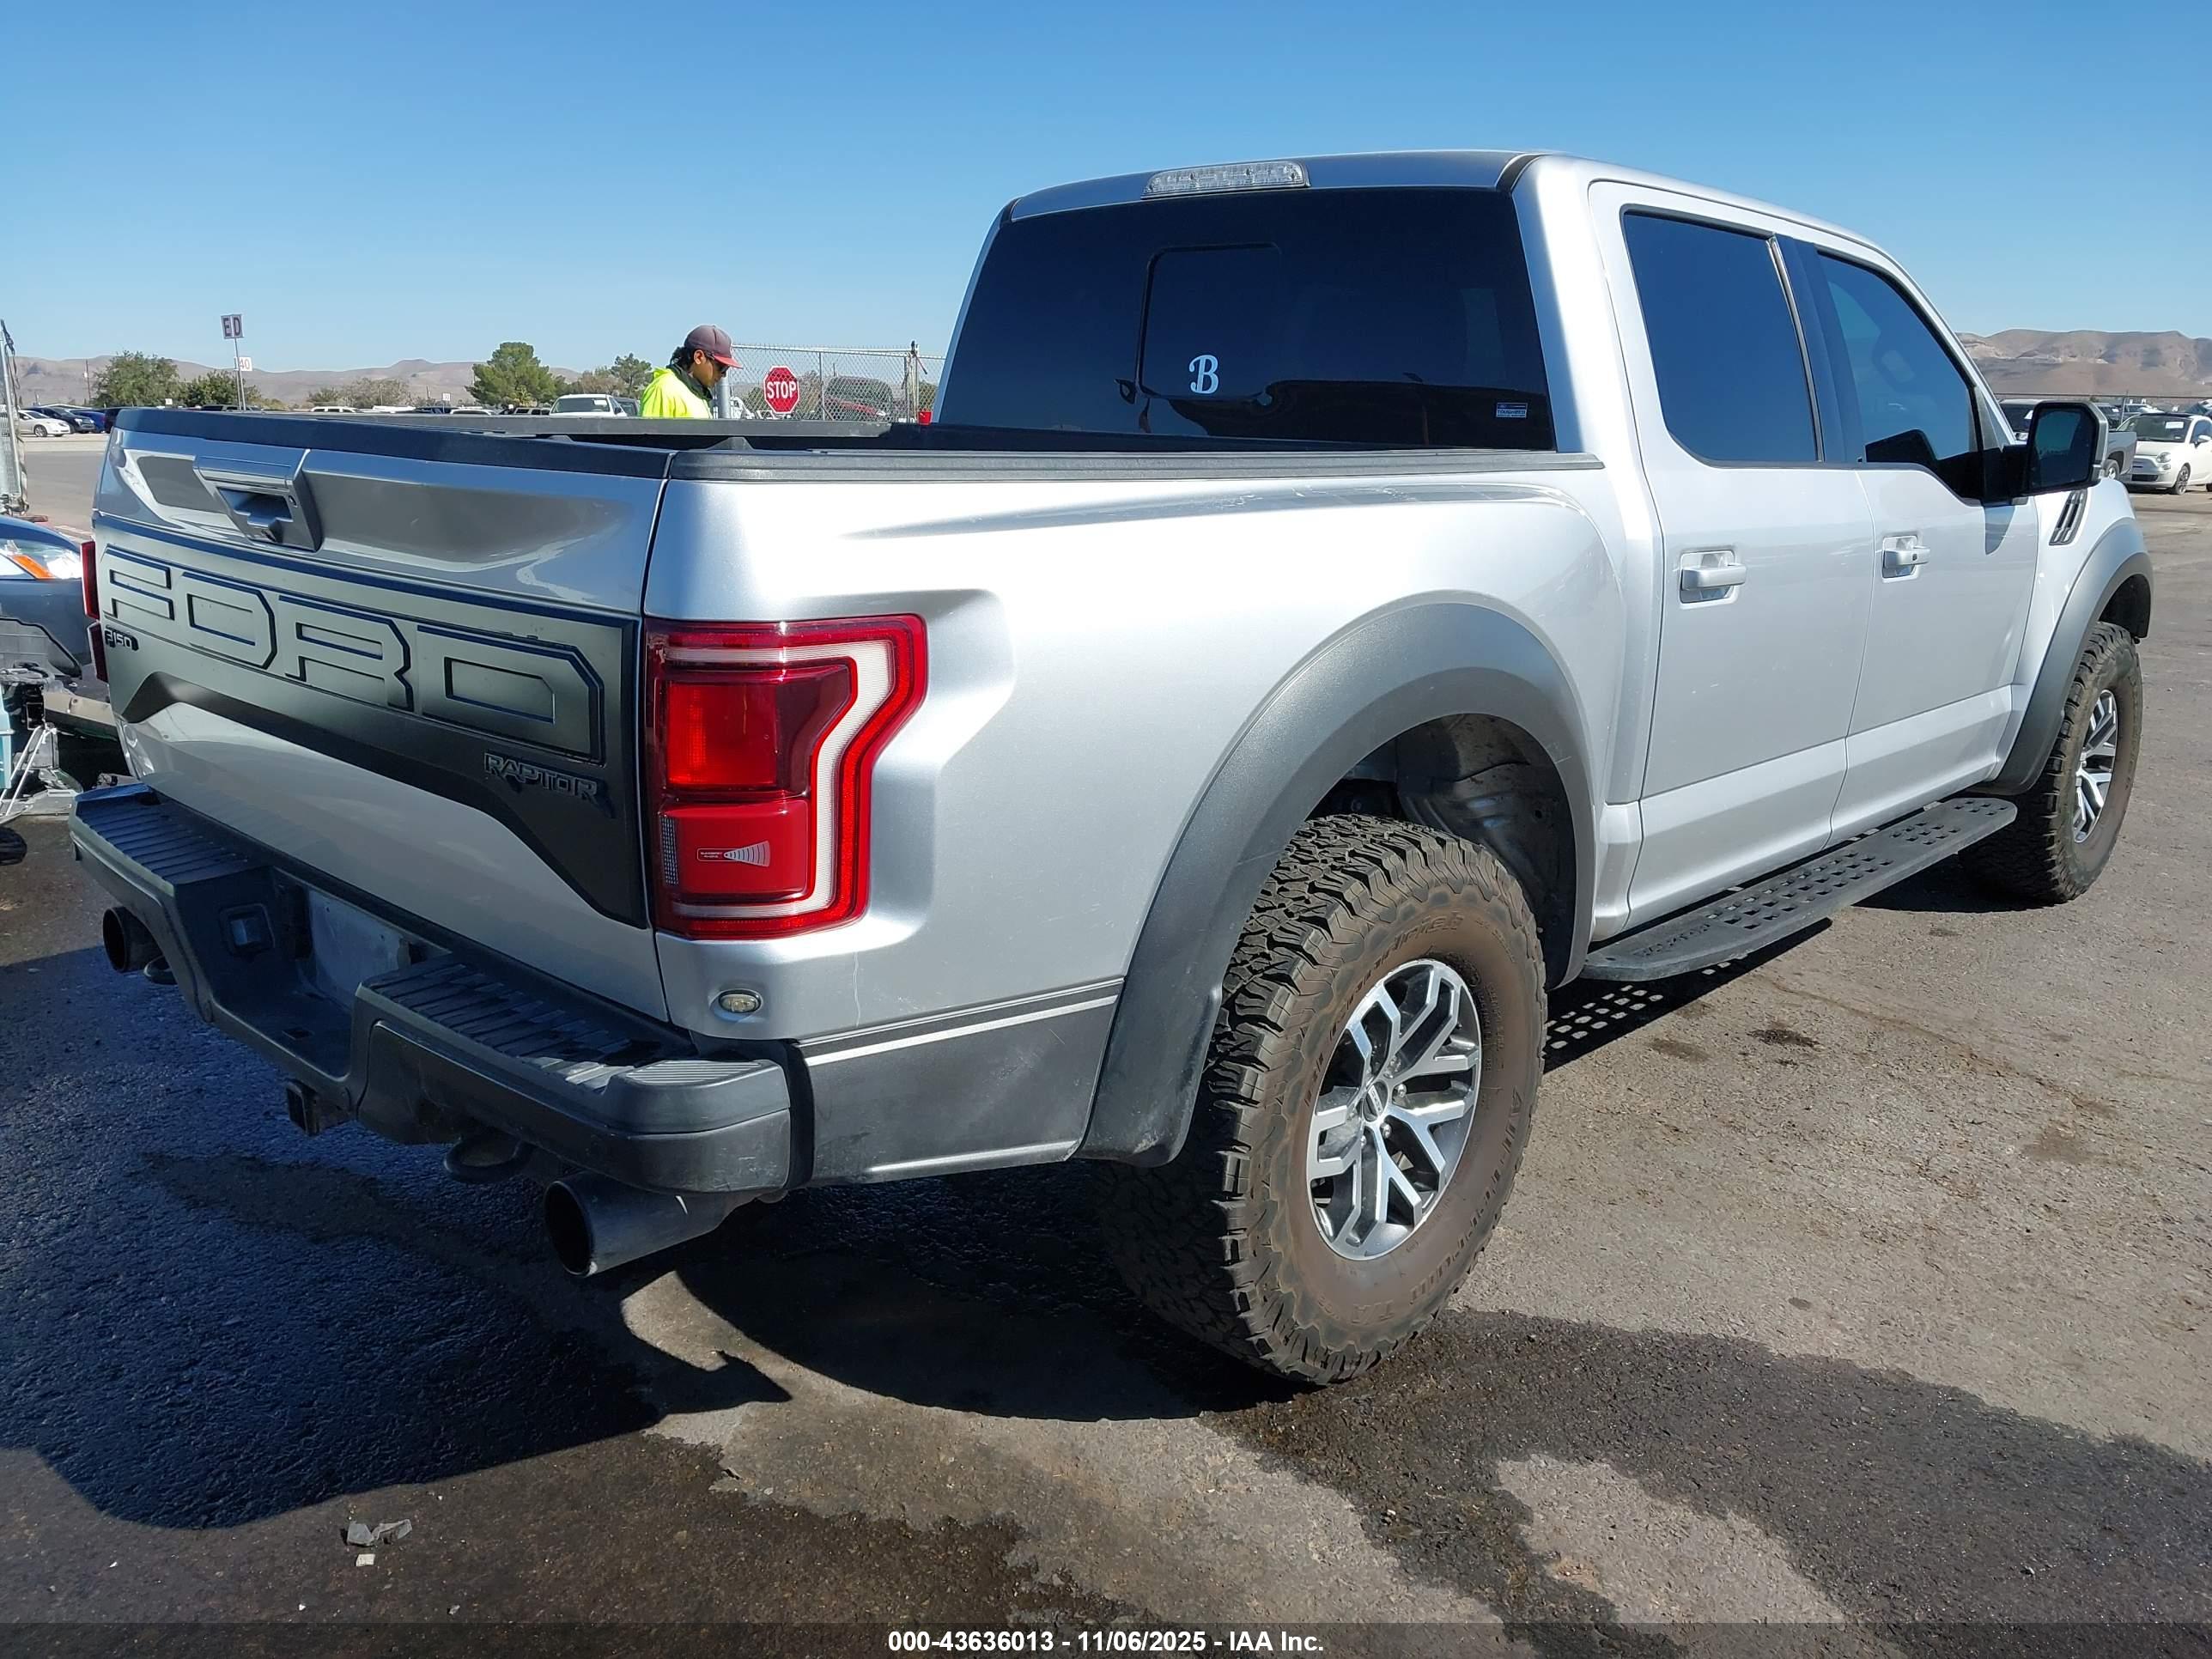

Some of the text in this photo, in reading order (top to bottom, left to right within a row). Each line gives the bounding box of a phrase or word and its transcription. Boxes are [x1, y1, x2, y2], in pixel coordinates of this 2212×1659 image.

[222, 316, 241, 337] ED
[767, 380, 797, 399] STOP
[1188, 355, 1218, 394] B
[101, 542, 606, 767] FORD
[483, 752, 602, 805] RAPTOR
